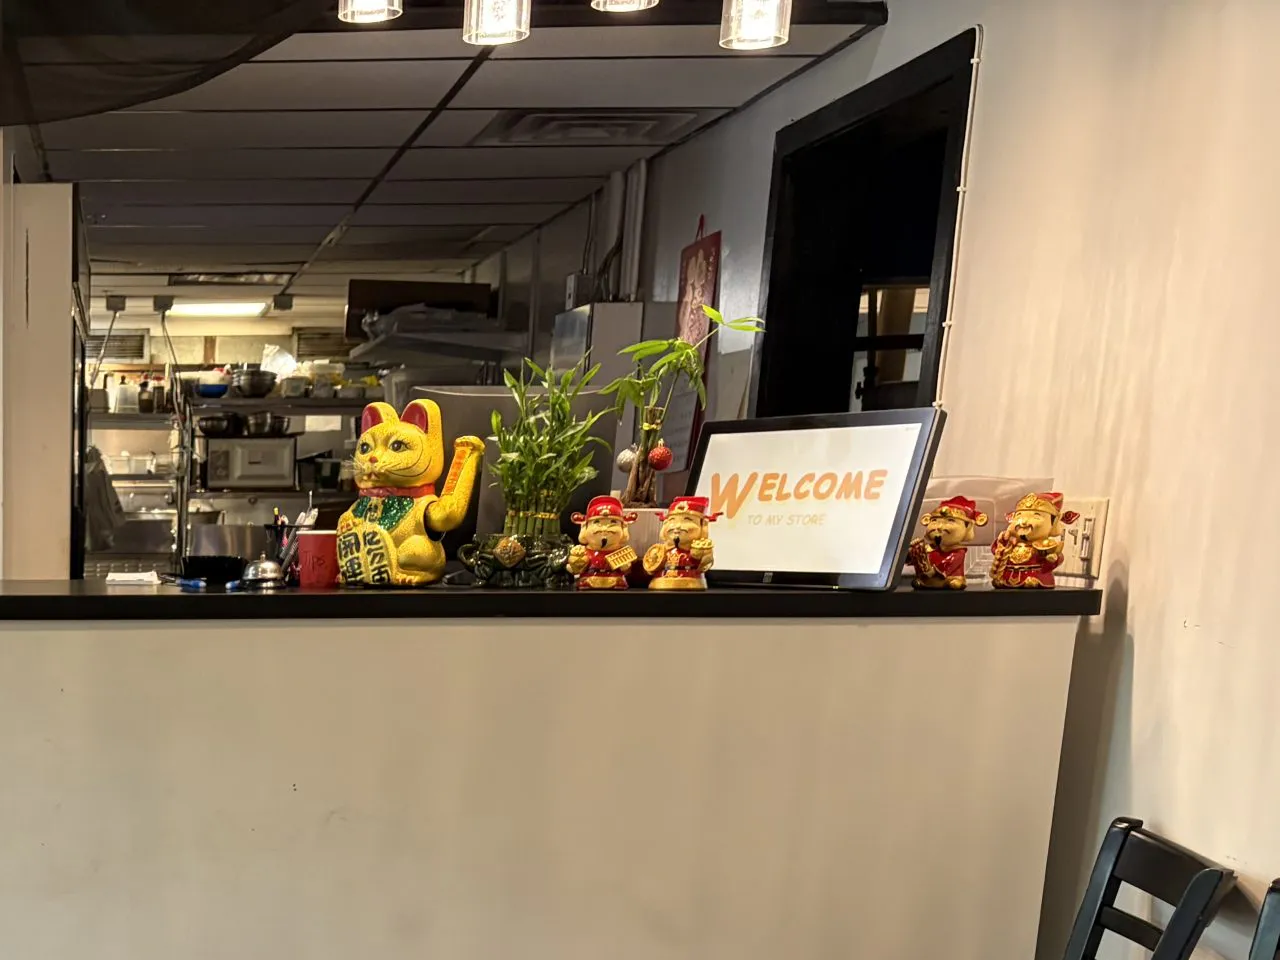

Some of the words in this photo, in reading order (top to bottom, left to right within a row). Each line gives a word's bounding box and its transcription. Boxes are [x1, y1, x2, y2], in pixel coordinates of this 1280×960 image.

[710, 469, 888, 519] WELCOME
[747, 513, 763, 526] TO
[765, 513, 783, 526] MY
[786, 512, 826, 526] STORE
